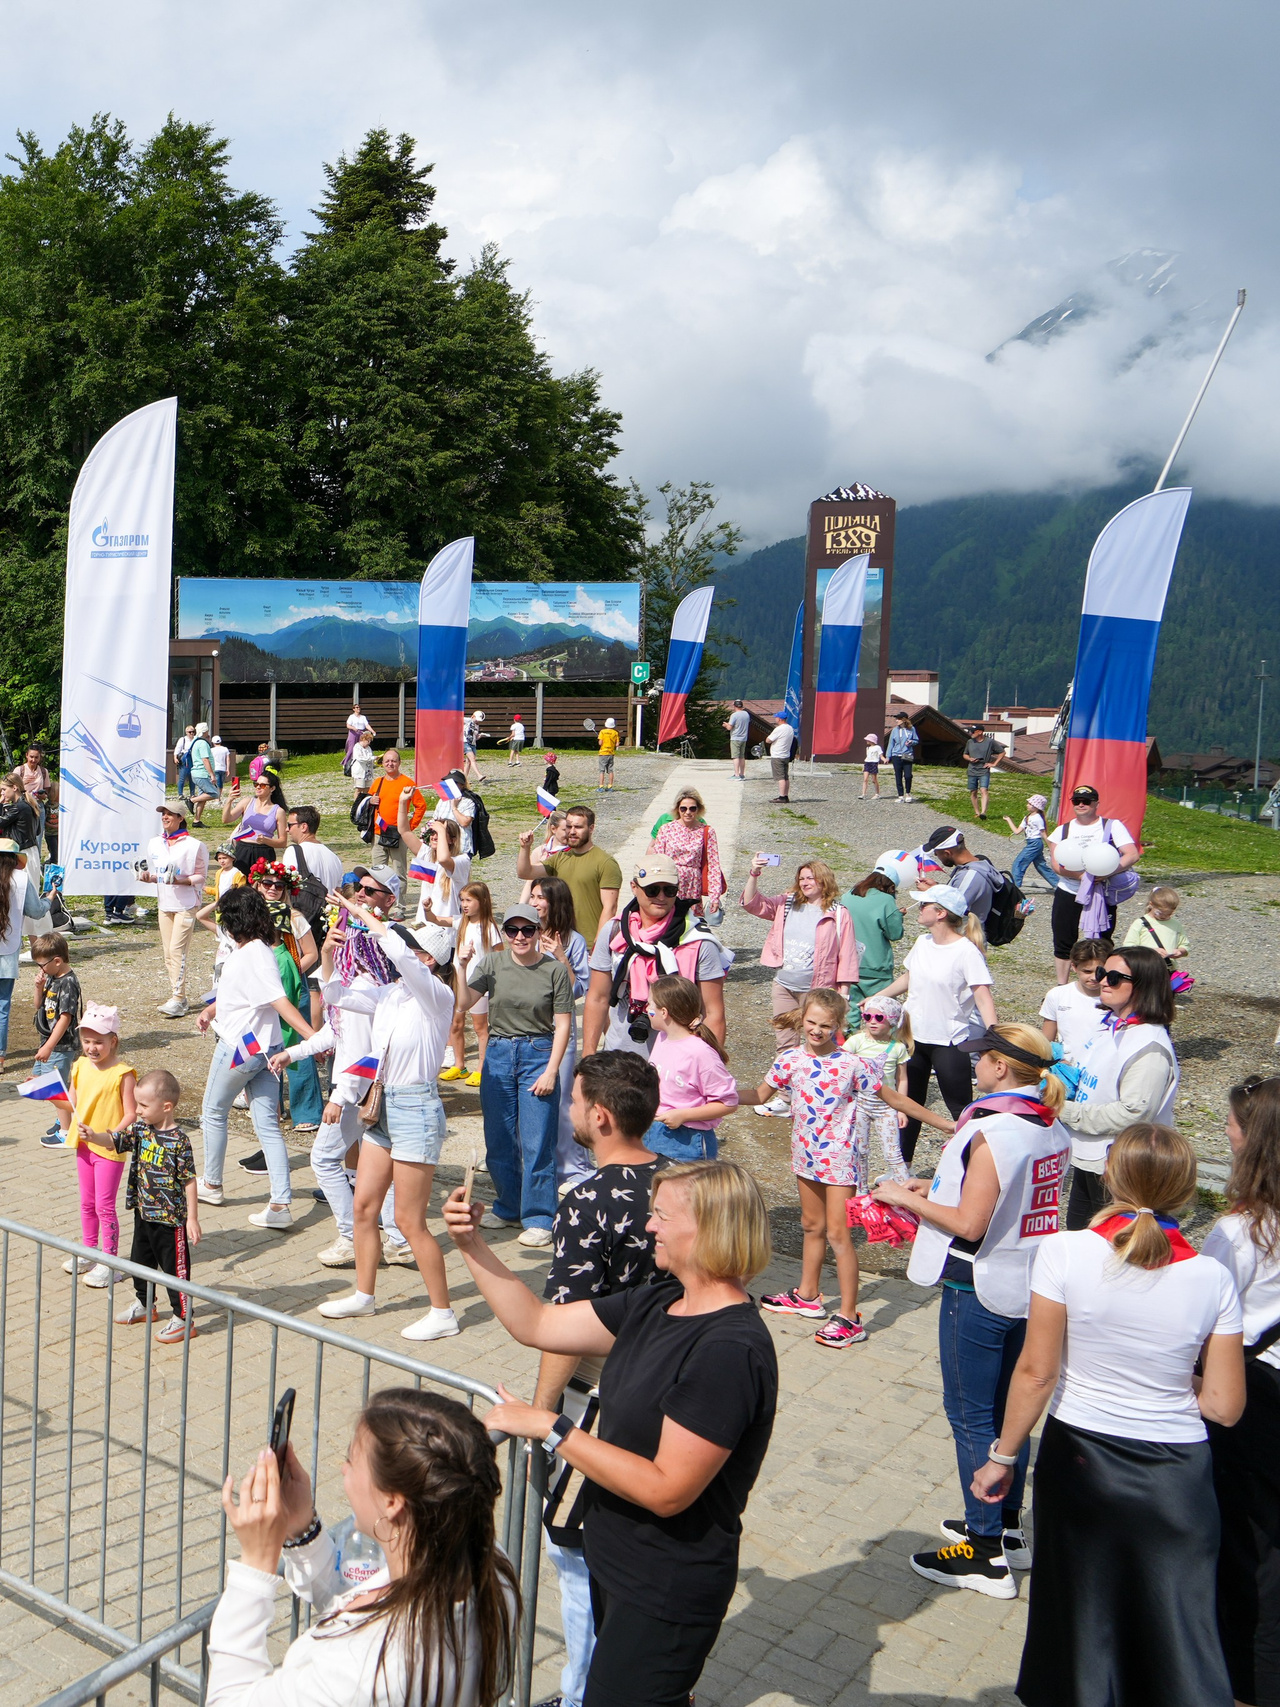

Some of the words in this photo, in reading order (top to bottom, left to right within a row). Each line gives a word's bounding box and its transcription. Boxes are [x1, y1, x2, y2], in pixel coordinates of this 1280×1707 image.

[824, 515, 880, 532] ПОЛЯНА
[110, 535, 149, 547] ГАЗПРОМ
[825, 528, 877, 549] 1389
[80, 839, 140, 854] Курорт
[75, 858, 130, 872] Газпро
